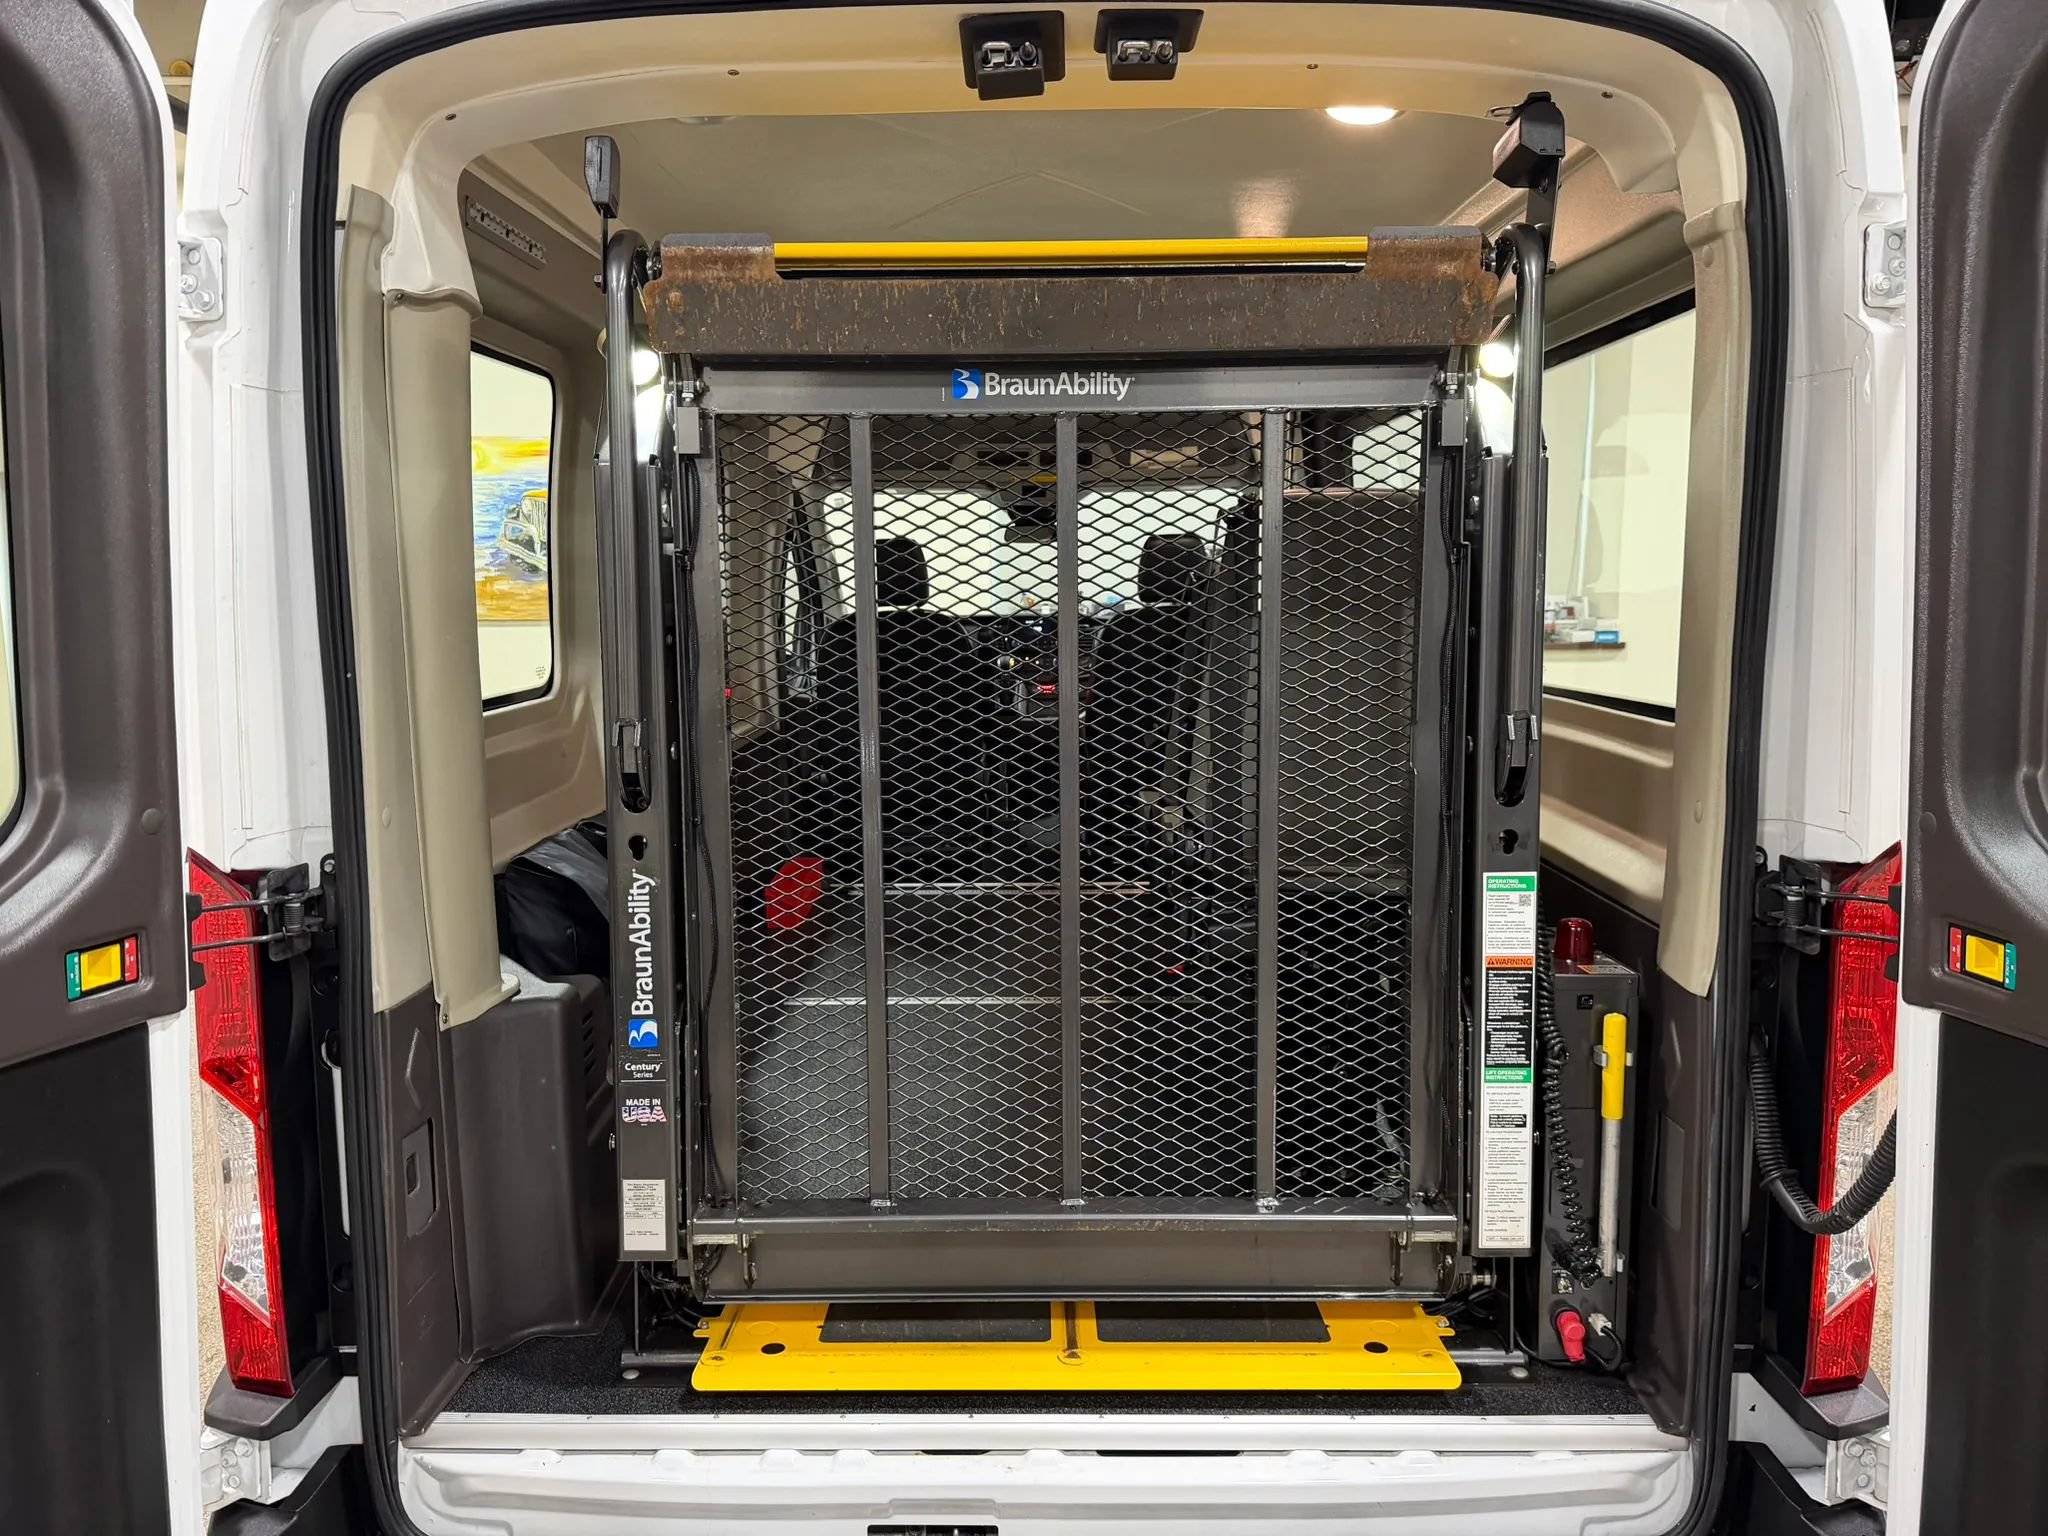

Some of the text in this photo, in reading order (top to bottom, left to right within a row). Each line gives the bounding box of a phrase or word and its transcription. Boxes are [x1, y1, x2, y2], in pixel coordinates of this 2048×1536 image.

[984, 371, 1131, 402] BraunAbility
[628, 874, 656, 1015] BraunAbility
[1495, 958, 1532, 966] WARNING
[624, 1062, 661, 1073] Century
[633, 1071, 653, 1079] Series
[626, 1098, 661, 1106] MADE IN
[622, 1106, 668, 1123] USA
